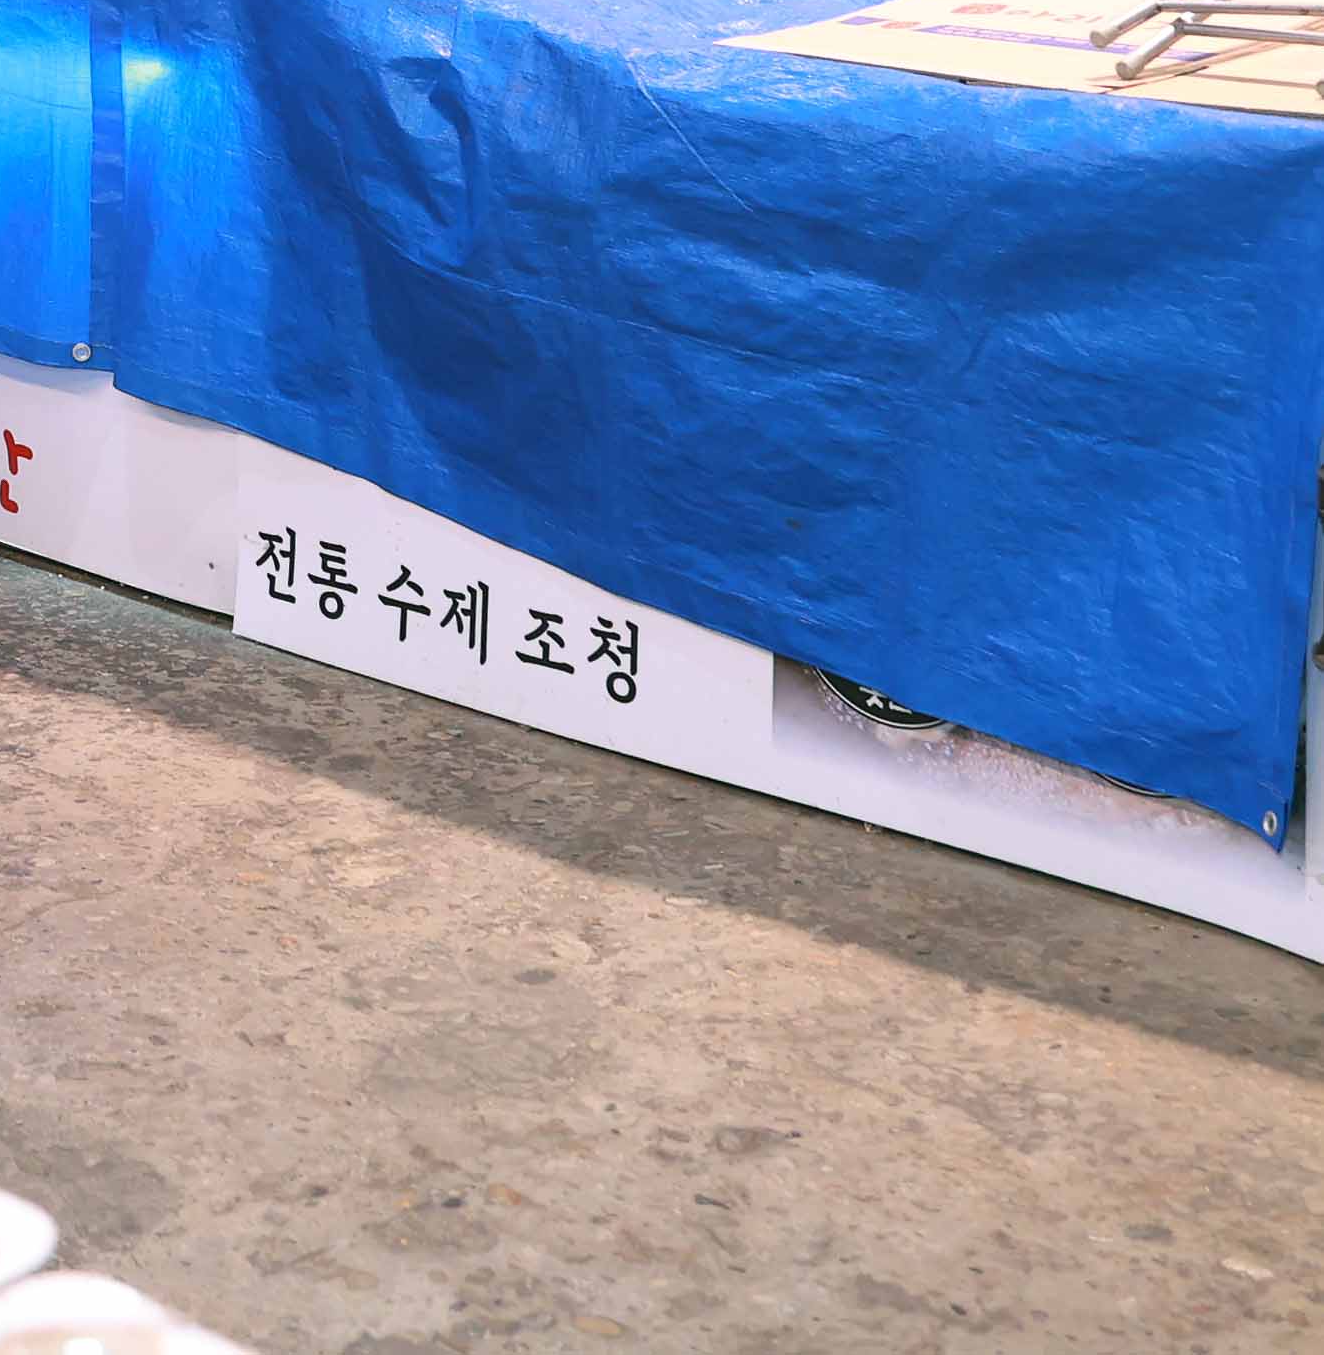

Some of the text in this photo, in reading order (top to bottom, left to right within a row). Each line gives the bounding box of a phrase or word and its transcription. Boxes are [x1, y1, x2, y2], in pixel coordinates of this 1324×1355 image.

[255, 525, 640, 705] 전통 수제 조청
